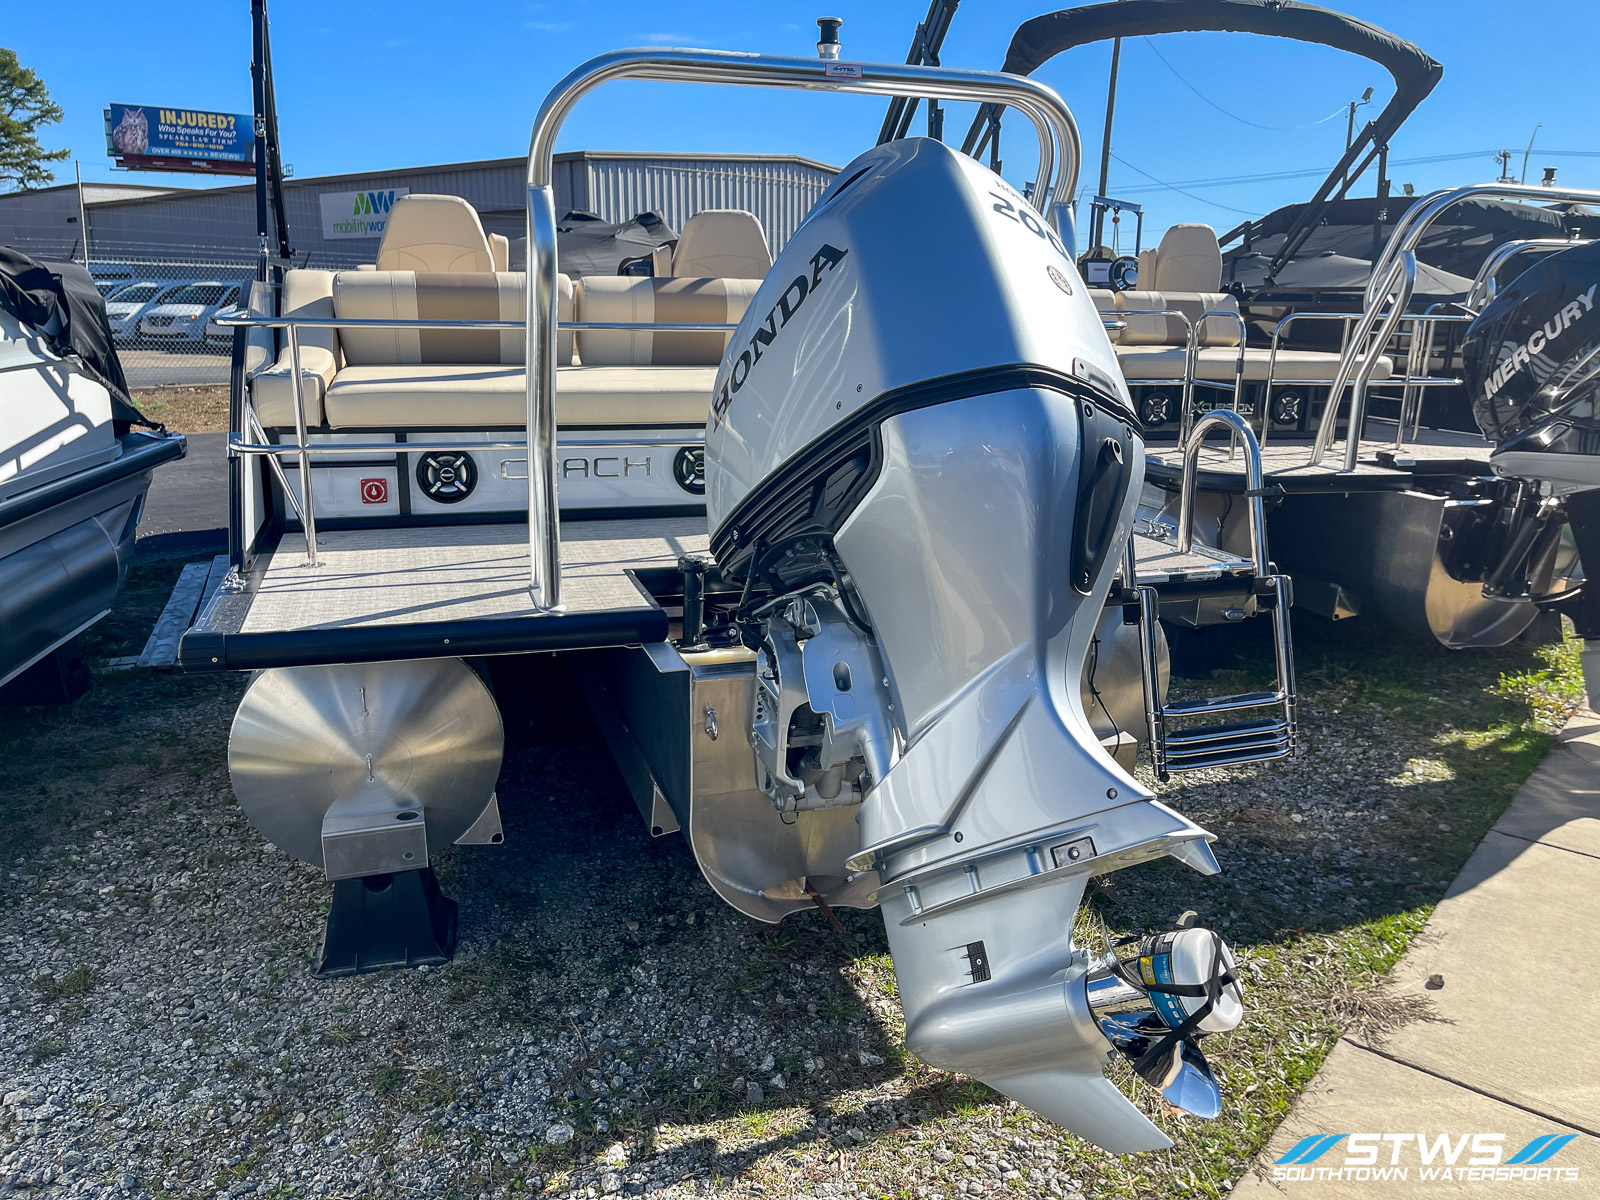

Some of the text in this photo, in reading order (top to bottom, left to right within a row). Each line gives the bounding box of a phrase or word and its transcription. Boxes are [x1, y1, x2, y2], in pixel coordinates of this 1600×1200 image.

[159, 110, 235, 129] INJURED?
[158, 124, 237, 138] Who Speaks For You?
[159, 134, 189, 142] SPEAKS
[192, 135, 209, 143] LAW
[333, 219, 386, 236] mobilitywor
[988, 190, 1070, 262] 200
[711, 243, 850, 434] HONDA
[1483, 283, 1598, 401] MERCURY
[1191, 400, 1255, 414] XCURSON
[501, 456, 651, 481] CACH
